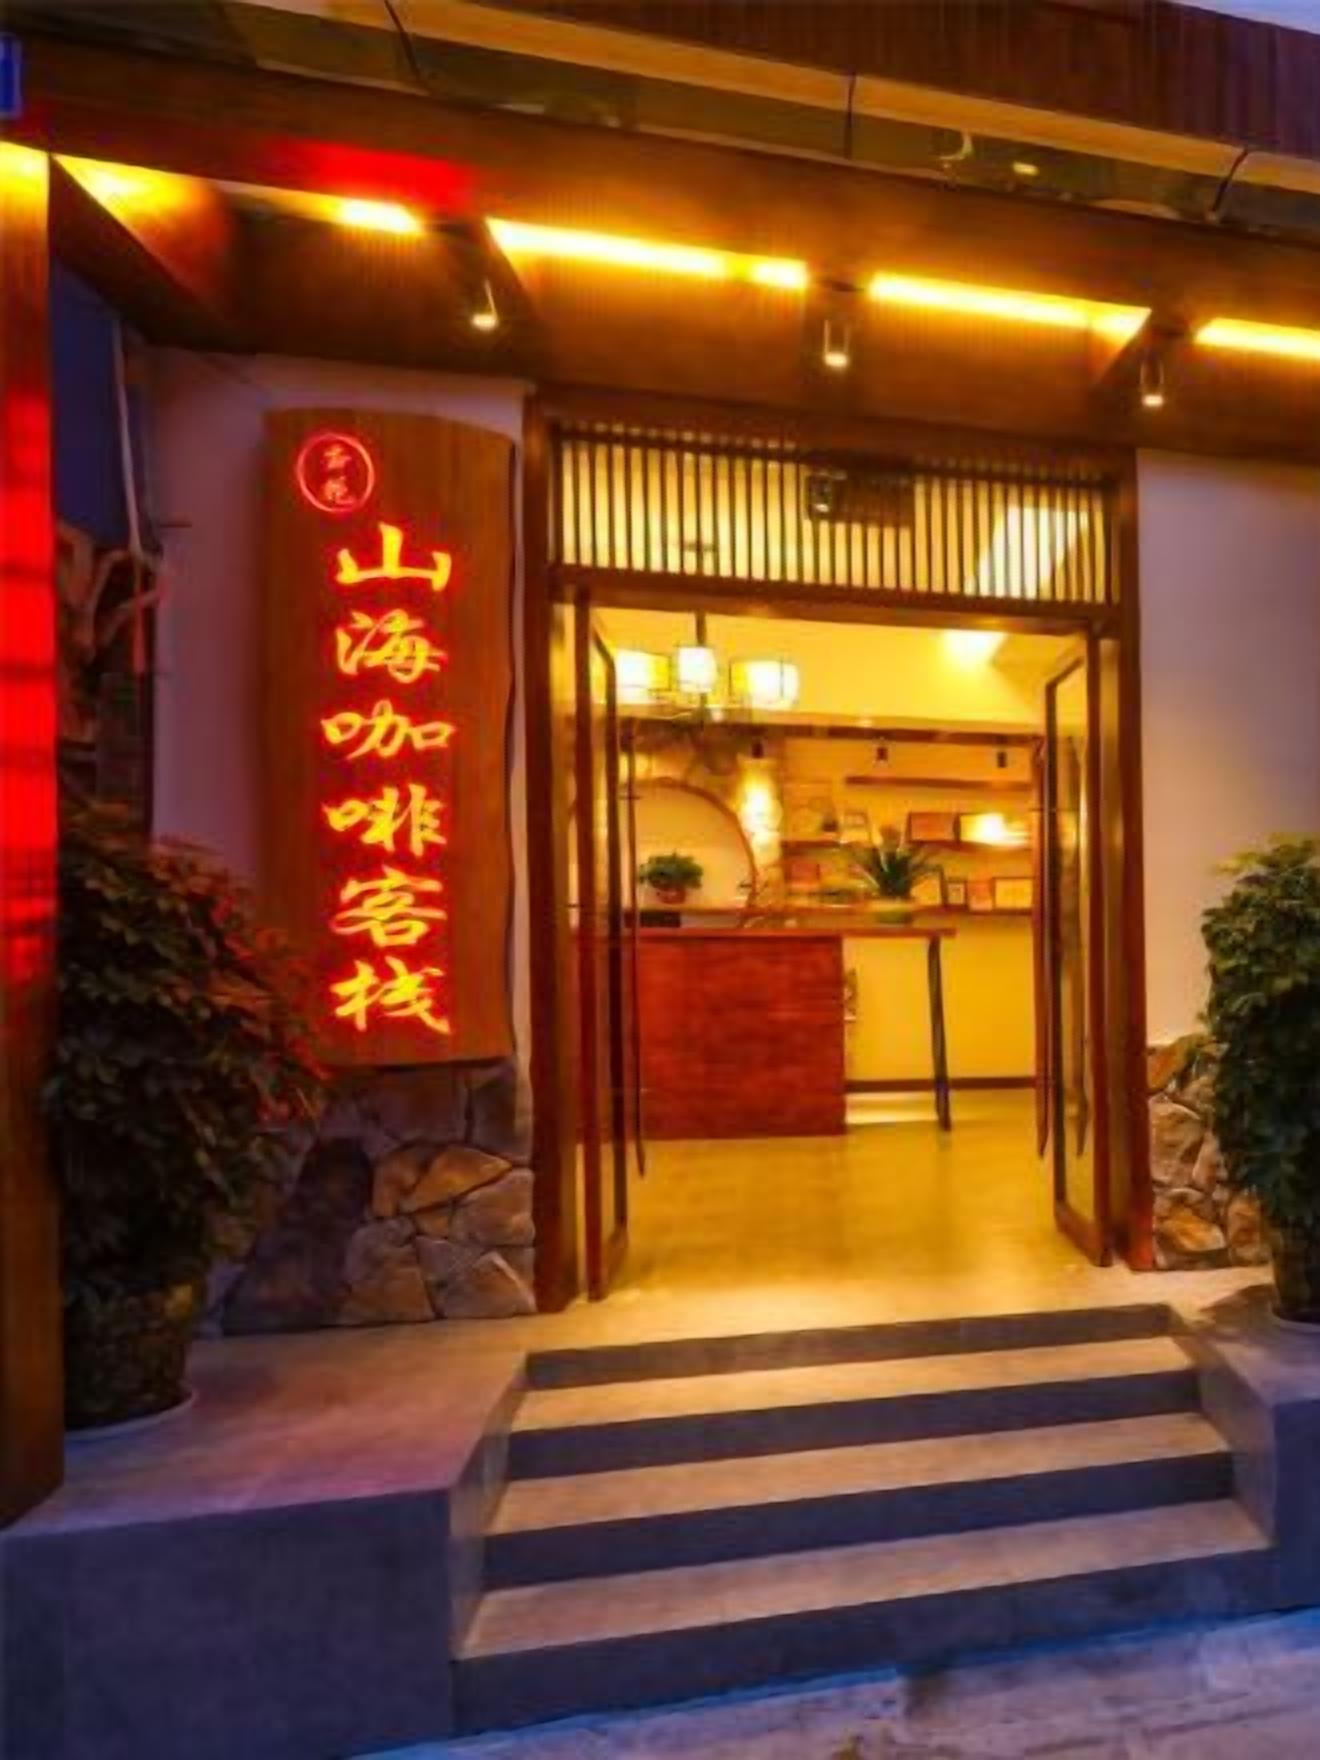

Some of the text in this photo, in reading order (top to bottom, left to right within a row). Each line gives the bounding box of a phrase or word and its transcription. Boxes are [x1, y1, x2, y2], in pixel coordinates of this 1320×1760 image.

[320, 523, 455, 1035] 山海咖啡客栈
